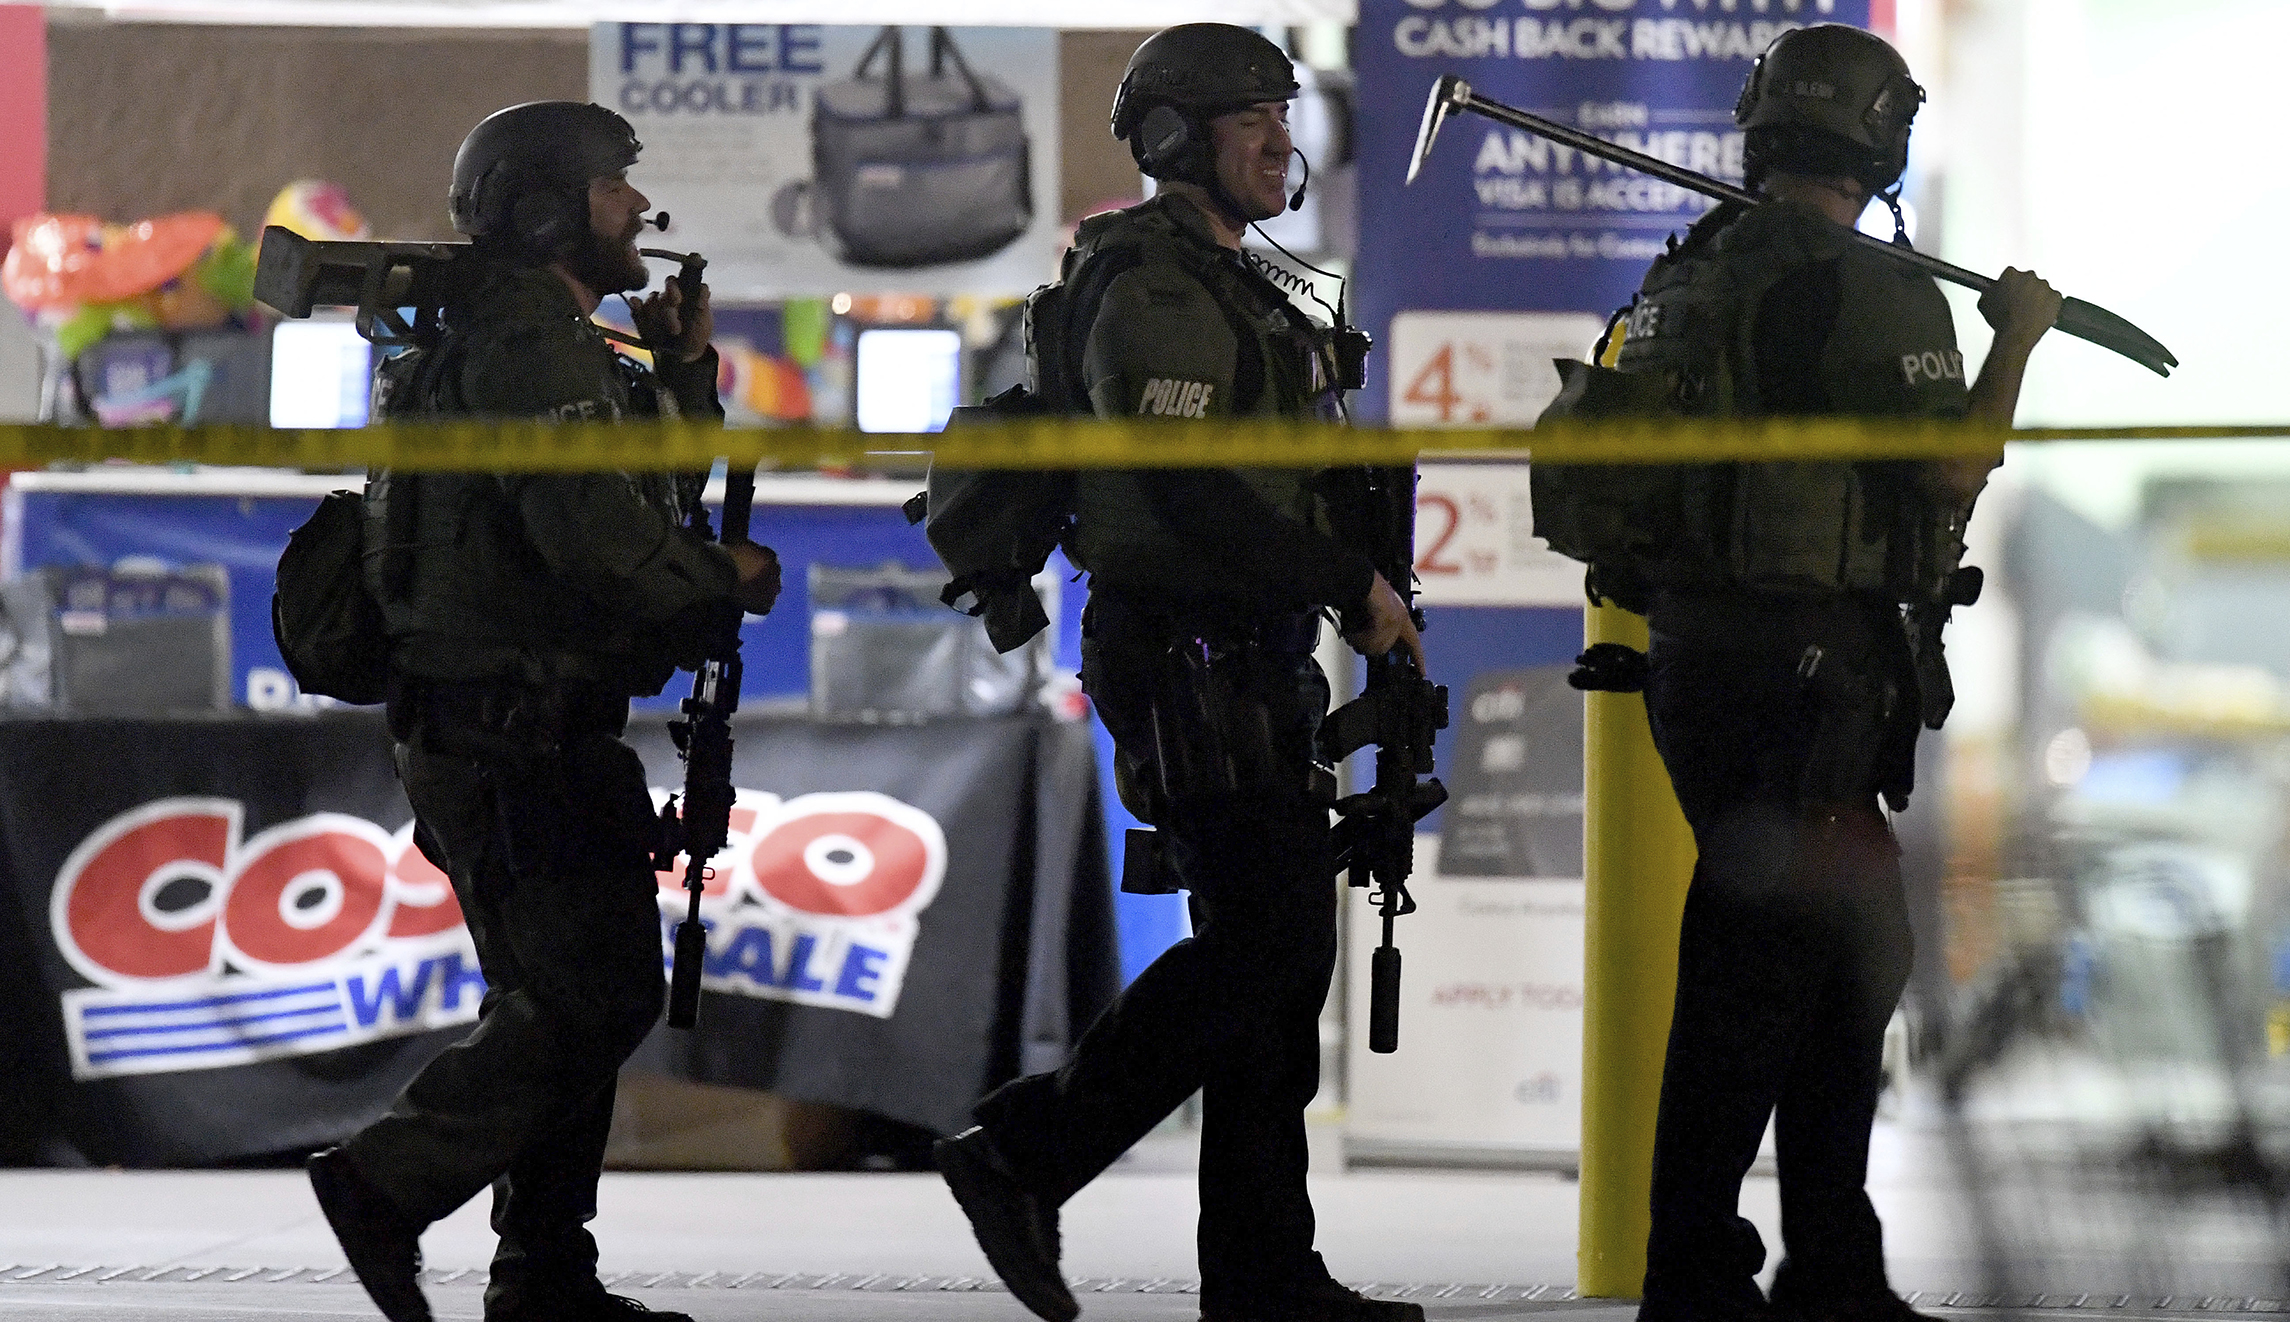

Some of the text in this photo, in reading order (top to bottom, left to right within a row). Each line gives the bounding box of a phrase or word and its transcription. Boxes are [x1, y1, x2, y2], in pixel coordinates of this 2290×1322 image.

[620, 22, 823, 74] FREE
[1394, 16, 1510, 58] CASH
[1515, 17, 1626, 59] BACK
[620, 79, 798, 117] COOLER
[1138, 378, 1214, 419] POLICE
